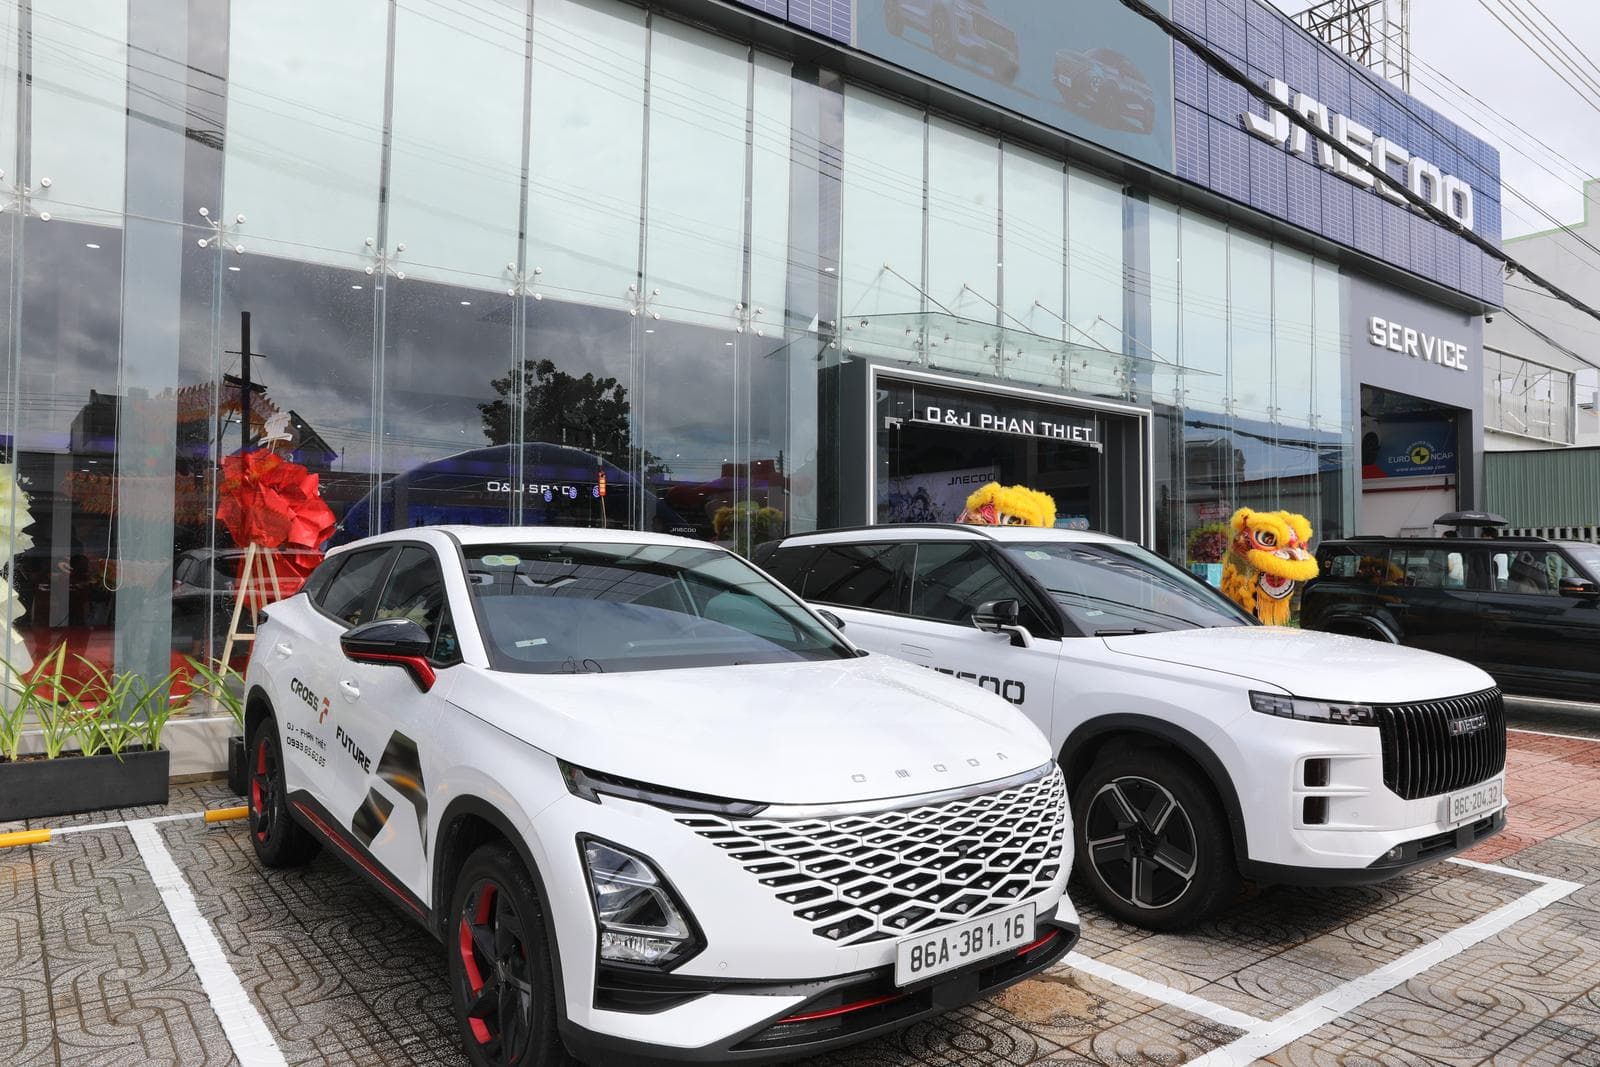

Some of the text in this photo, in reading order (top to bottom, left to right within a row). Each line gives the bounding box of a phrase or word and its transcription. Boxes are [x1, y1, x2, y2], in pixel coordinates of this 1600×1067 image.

[1241, 78, 1474, 231] JAECOO
[1370, 316, 1468, 371] SERVICE
[927, 406, 1093, 442] O&J PHAN THIET
[1388, 452, 1454, 464] EURO NCAP
[947, 472, 996, 486] JAECOO
[290, 677, 320, 712] CROSS
[336, 724, 371, 775] FUTURE
[851, 752, 1009, 784] OMODA
[1454, 786, 1498, 817] 86C-204.32
[910, 913, 1026, 973] 86A-381.16
